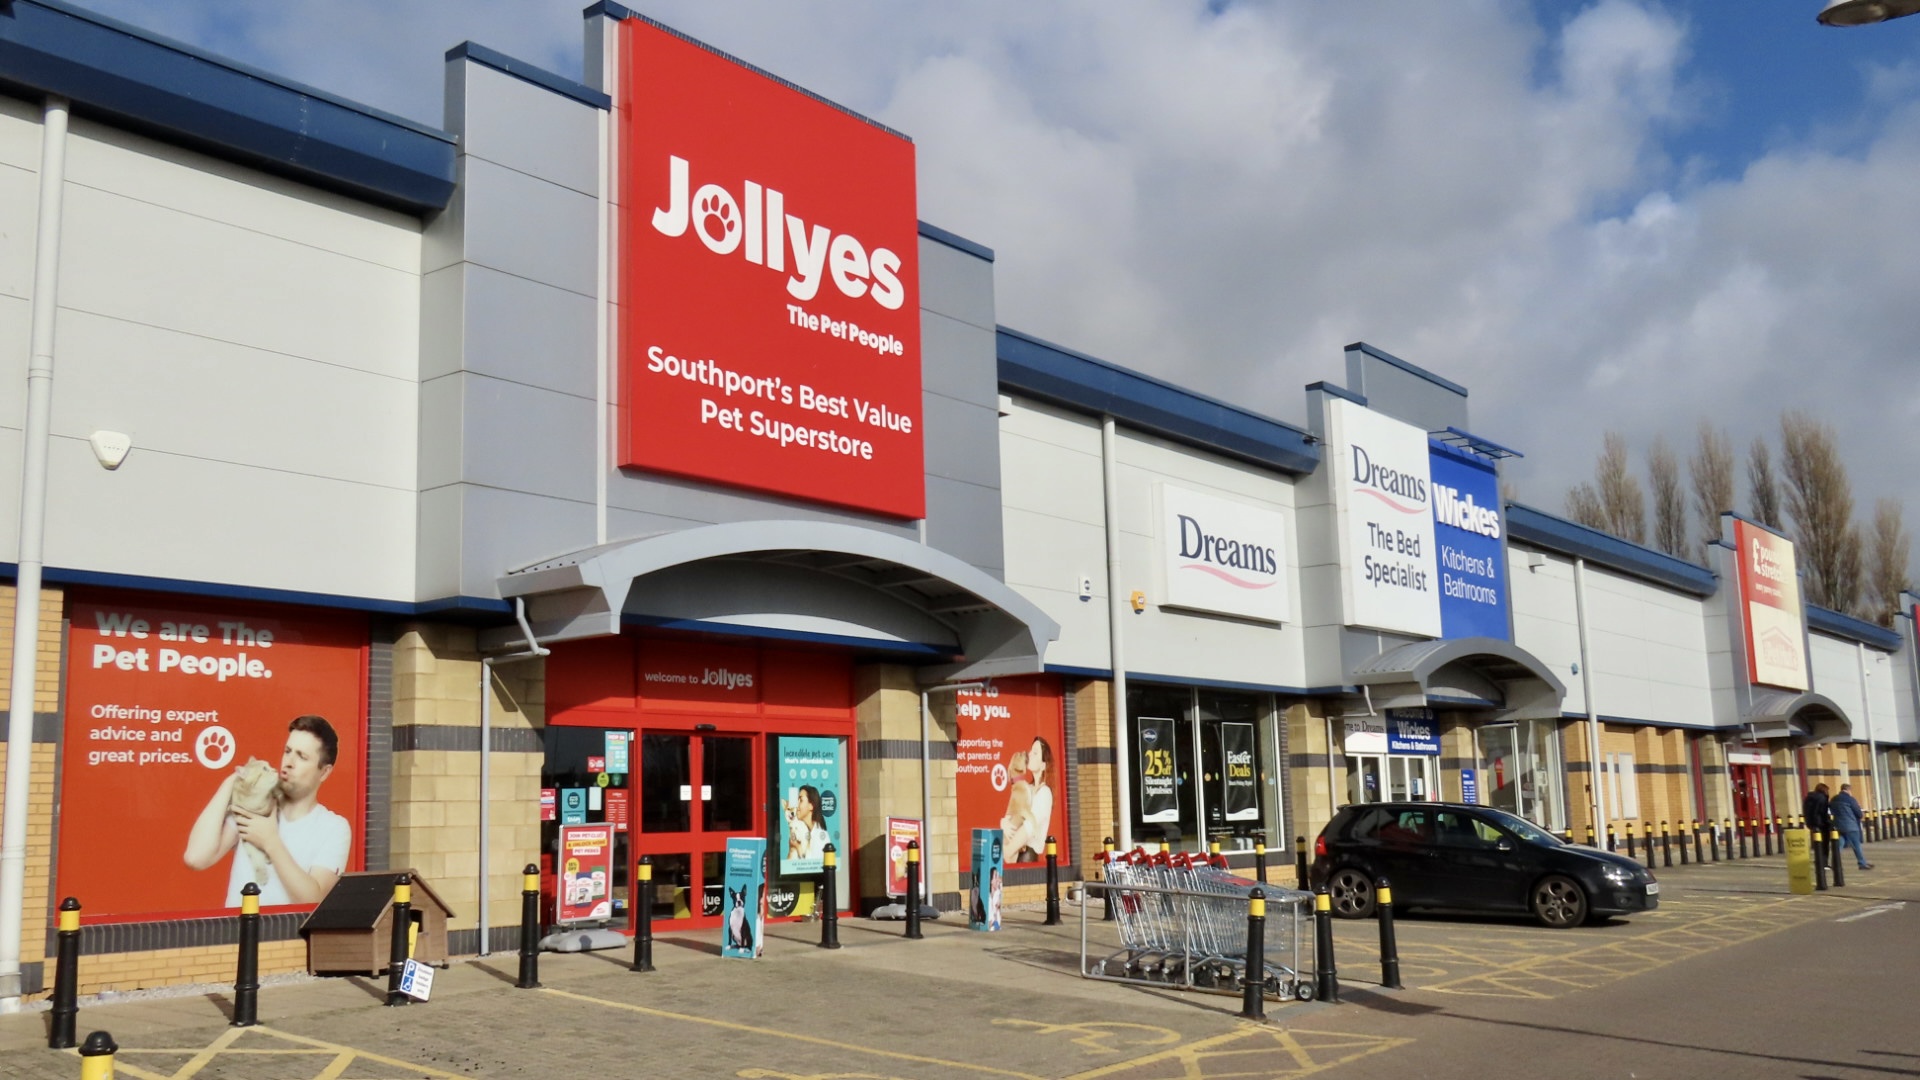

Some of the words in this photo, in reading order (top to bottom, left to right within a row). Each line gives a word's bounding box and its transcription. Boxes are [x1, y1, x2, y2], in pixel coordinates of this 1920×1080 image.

[652, 155, 904, 310] Jollyes
[787, 304, 819, 332] The
[821, 314, 847, 342] Pet
[849, 324, 904, 356] People
[647, 346, 793, 404] Southport's
[800, 385, 848, 419] Best
[853, 398, 912, 434] Value
[701, 399, 743, 432] Pet
[750, 411, 873, 460] Superstore
[1351, 443, 1427, 503] Dreams
[1433, 482, 1500, 539] Wickes
[1177, 514, 1278, 575] Dreams
[1367, 521, 1393, 552] The
[1397, 529, 1421, 559] Bed
[1365, 555, 1428, 593] Specialist
[1442, 545, 1485, 576] Kitchens
[1486, 557, 1495, 580] &
[1444, 574, 1497, 606] Bathrooms
[96, 611, 150, 641] We
[159, 621, 209, 644] are
[218, 622, 273, 648] The
[93, 644, 149, 672] Pet
[159, 648, 273, 682] People.
[645, 672, 687, 684] welcome
[689, 674, 698, 684] to
[701, 668, 753, 690] Jollyes
[985, 687, 998, 698] to
[91, 704, 162, 724] Offering
[166, 708, 218, 724] expert
[984, 704, 1011, 722] you.
[90, 725, 147, 742] advice
[151, 727, 182, 742] and
[957, 738, 991, 750] upporting
[992, 738, 1003, 748] the
[1396, 721, 1431, 740] Wickes
[89, 749, 134, 767] great
[140, 748, 193, 768] prices.
[783, 746, 811, 758] Incredible
[812, 749, 821, 759] pet
[967, 752, 992, 762] parents
[993, 751, 1000, 760] of
[1227, 750, 1251, 764] Easter
[1229, 764, 1251, 777] Deals
